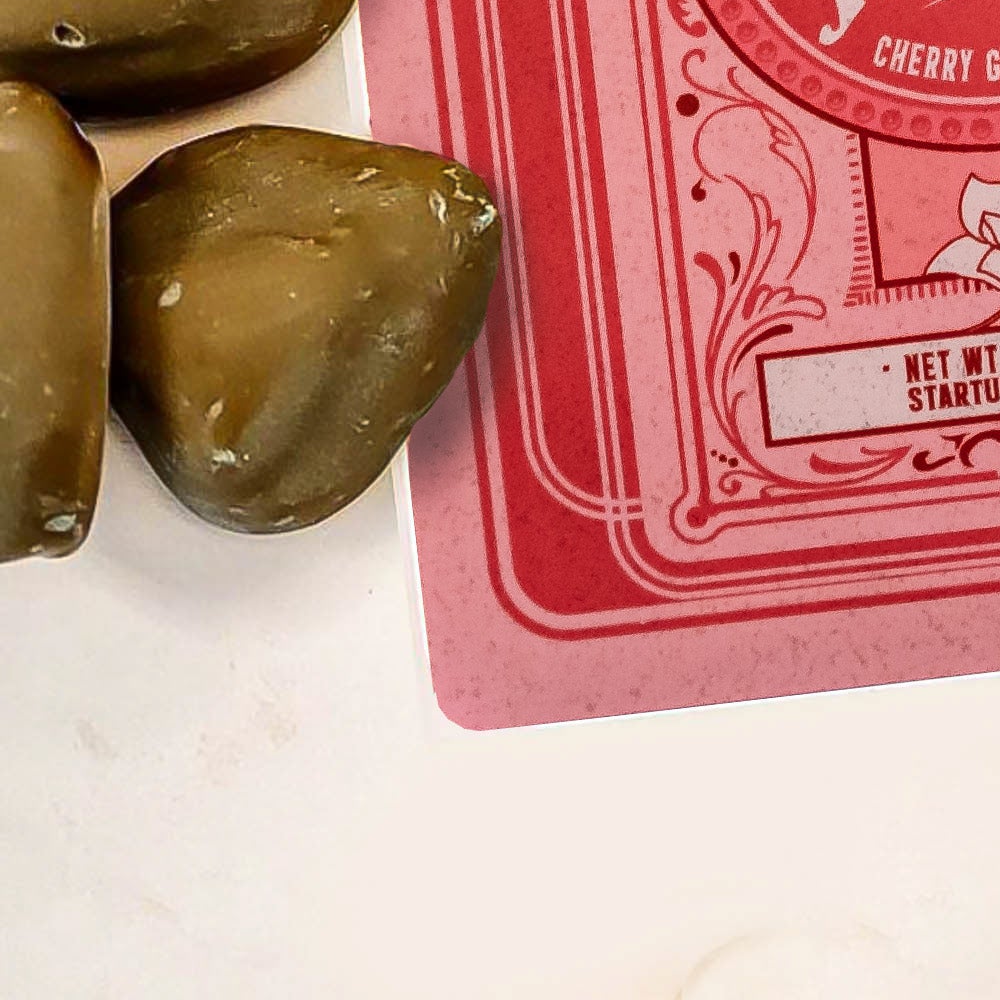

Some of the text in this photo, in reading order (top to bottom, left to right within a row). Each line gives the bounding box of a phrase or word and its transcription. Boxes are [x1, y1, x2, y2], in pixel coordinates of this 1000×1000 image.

[873, 34, 972, 82] CHERRY
[905, 350, 950, 383] NET
[962, 344, 997, 376] WT
